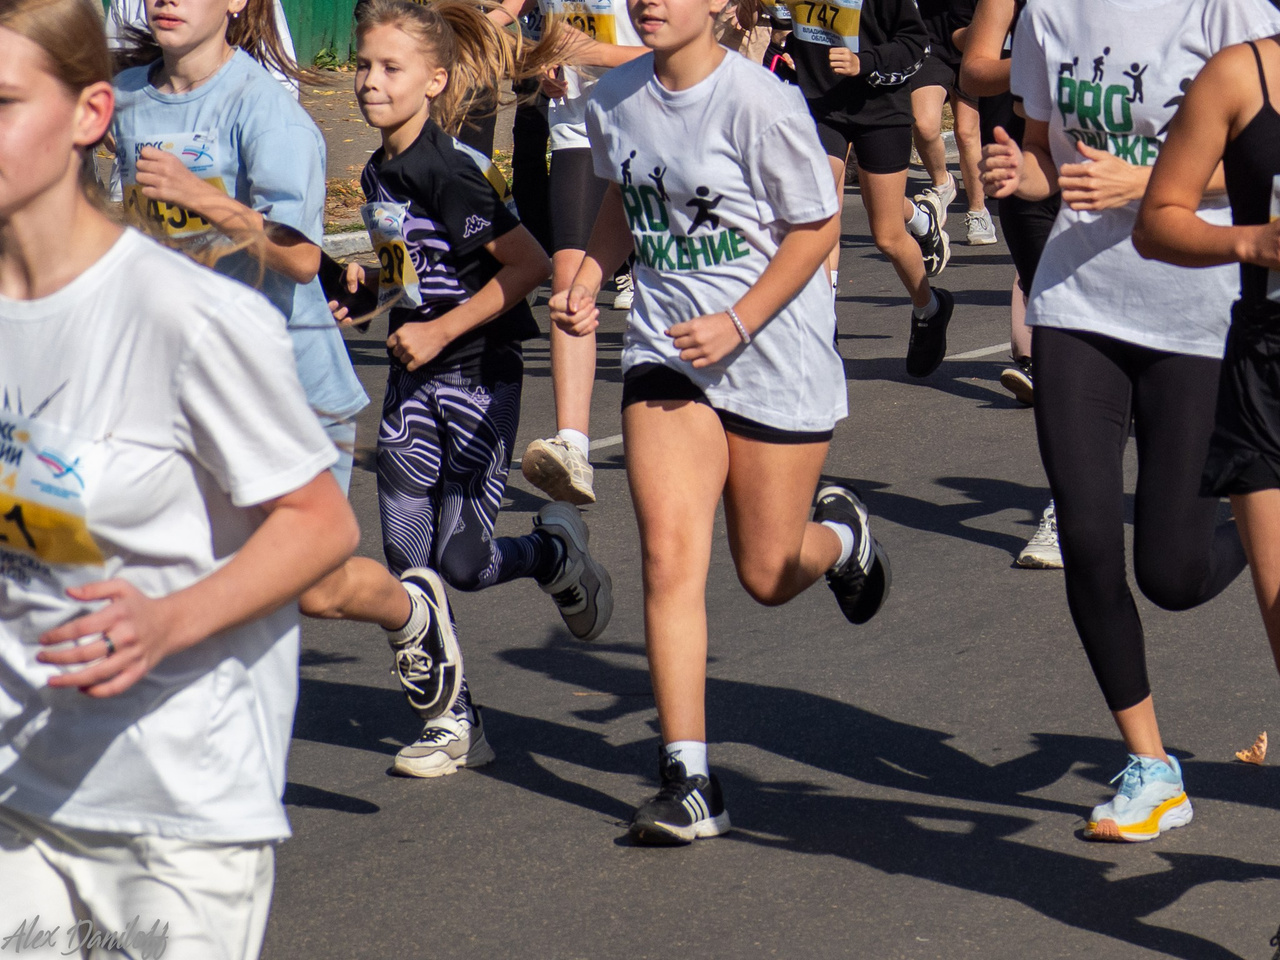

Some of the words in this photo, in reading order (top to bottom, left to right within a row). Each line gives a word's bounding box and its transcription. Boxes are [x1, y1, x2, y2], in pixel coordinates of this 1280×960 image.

[804, 1, 839, 29] 747
[1057, 76, 1134, 133] PRO
[620, 184, 669, 232] RO
[633, 227, 750, 271] ИЖЕНИЕ
